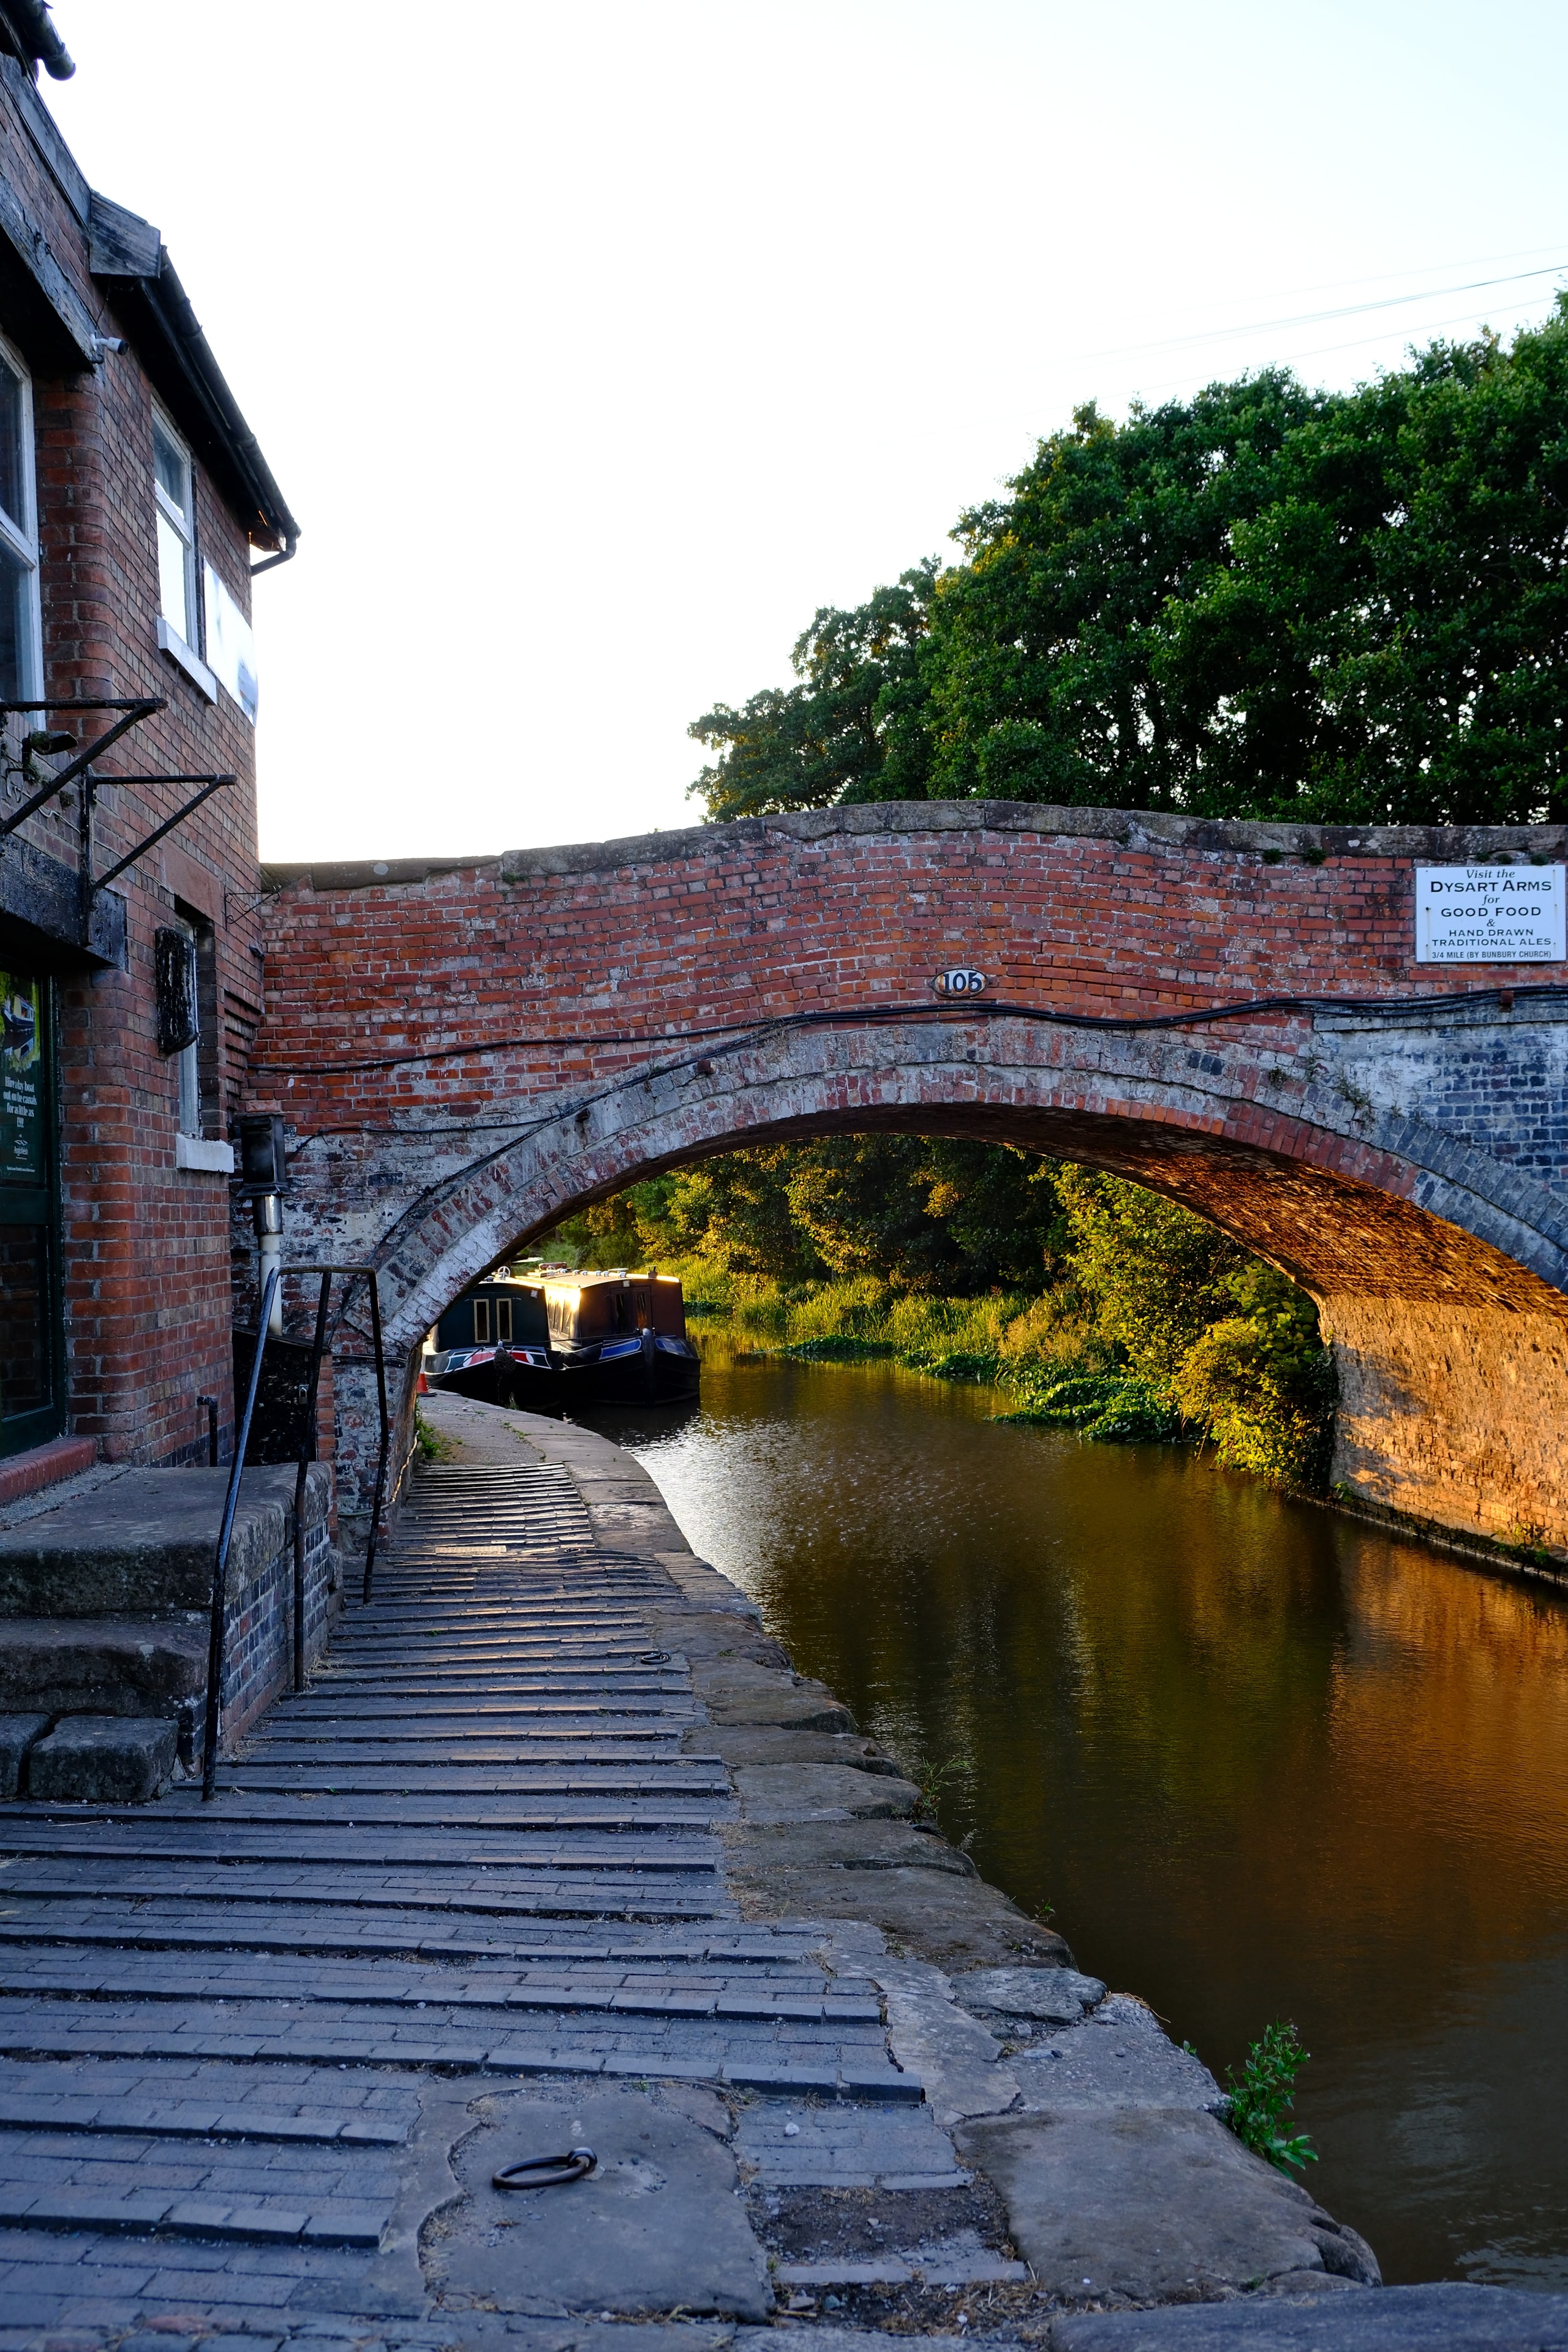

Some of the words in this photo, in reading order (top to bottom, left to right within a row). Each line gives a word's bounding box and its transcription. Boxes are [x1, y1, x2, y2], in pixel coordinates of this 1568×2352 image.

[1467, 870, 1492, 878] Visit
[1497, 869, 1515, 878] the
[1482, 894, 1500, 905] for
[1441, 908, 1488, 917] GOOD
[1496, 907, 1541, 916] FOOD
[943, 972, 982, 993] 105
